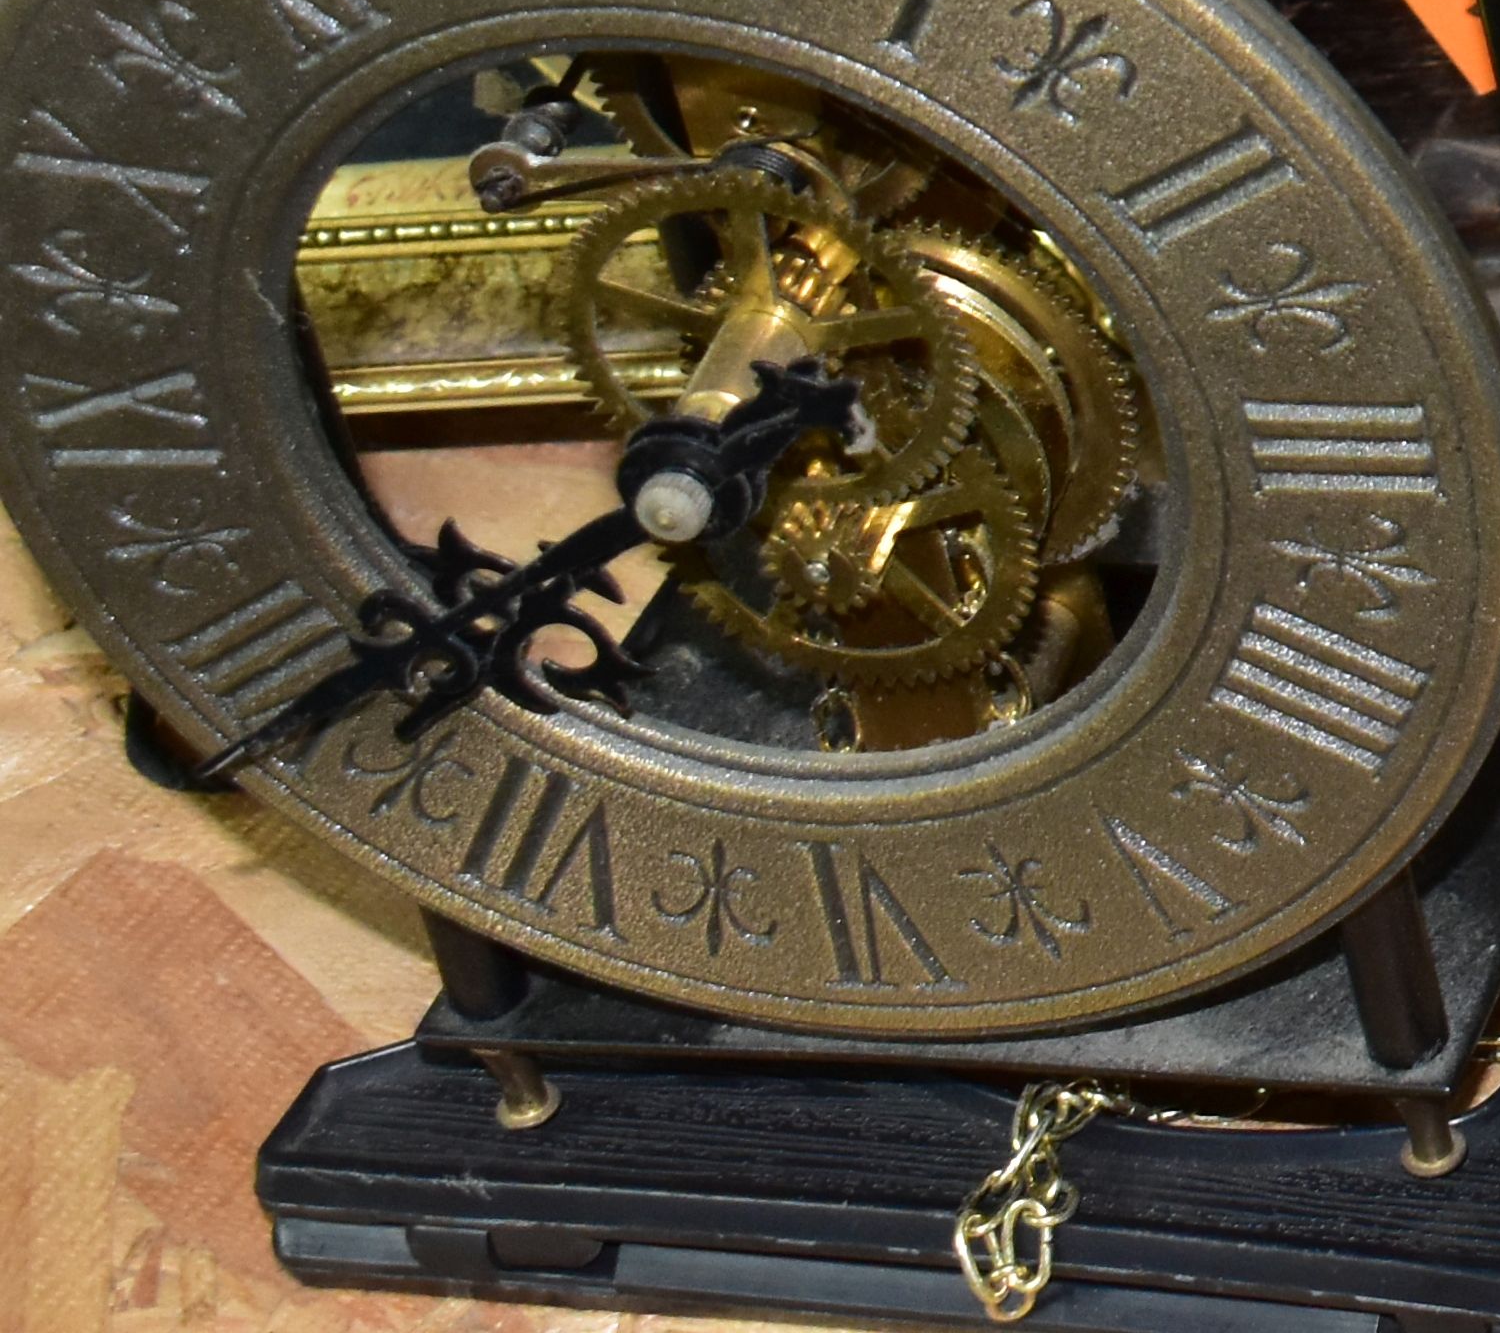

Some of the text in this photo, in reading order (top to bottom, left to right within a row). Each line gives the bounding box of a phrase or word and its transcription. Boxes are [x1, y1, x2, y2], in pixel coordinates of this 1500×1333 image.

[12, 108, 213, 255] X
[1108, 121, 1305, 247] II
[20, 370, 225, 468] IX
[1242, 399, 1442, 500] III
[1208, 600, 1435, 778] IIII
[1104, 805, 1235, 941] V
